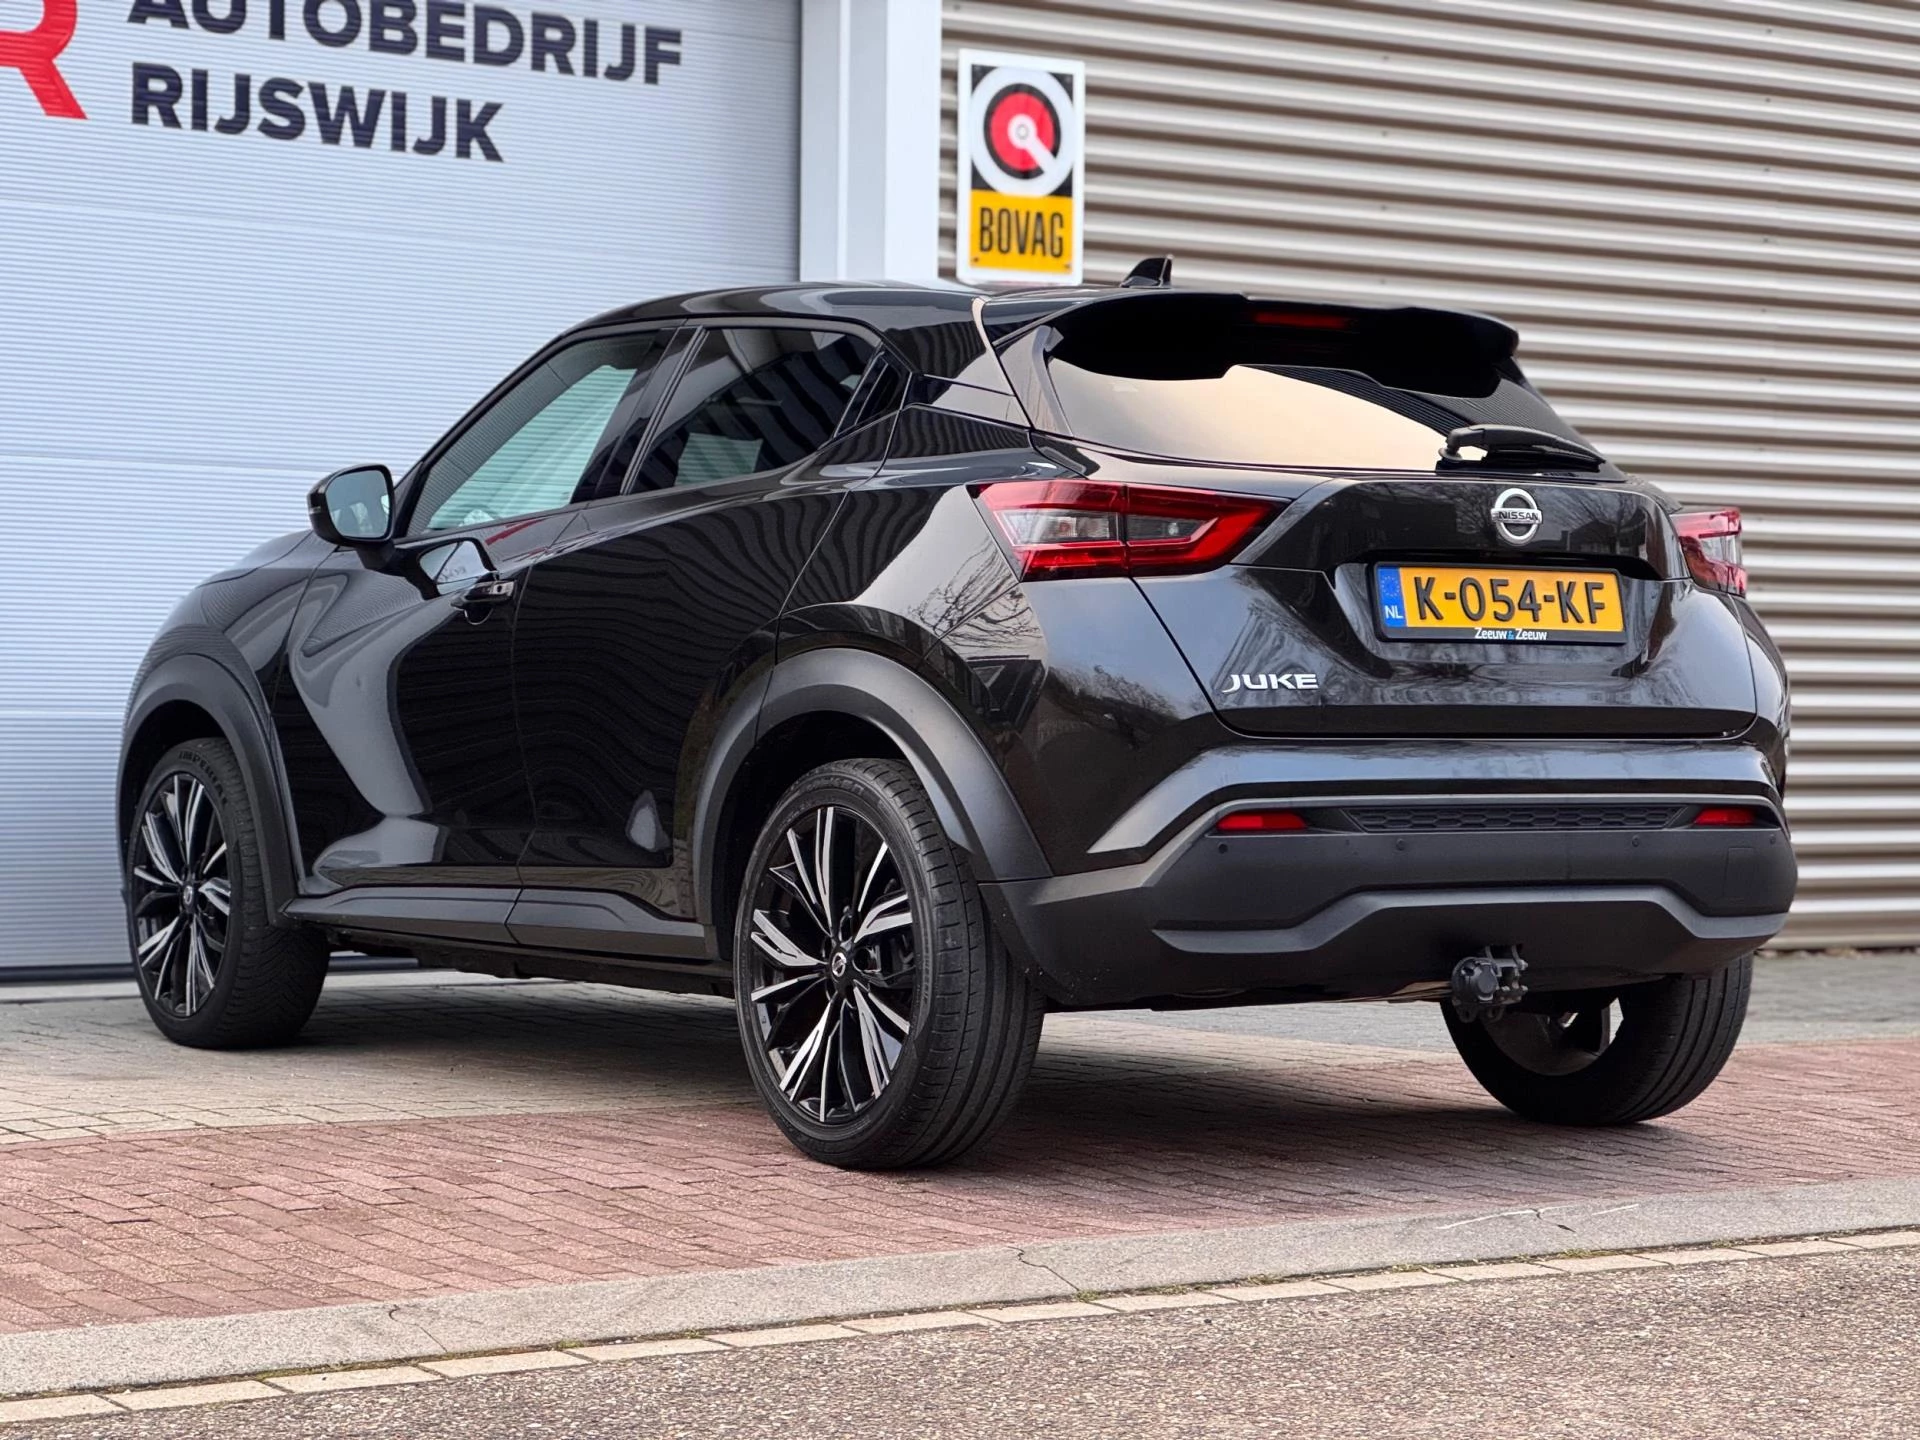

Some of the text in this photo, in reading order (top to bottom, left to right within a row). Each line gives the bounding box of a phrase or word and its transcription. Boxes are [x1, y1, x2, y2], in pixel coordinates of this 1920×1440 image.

[131, 62, 504, 162] RIJSWIJK
[979, 207, 1065, 259] BOVAG
[1498, 511, 1539, 521] NISSAN
[1413, 576, 1606, 624] K-054-KF
[1385, 605, 1404, 620] NL
[1474, 627, 1507, 640] Zeeuw
[1515, 628, 1548, 640] Zeeuw
[1222, 673, 1319, 693] JUKE
